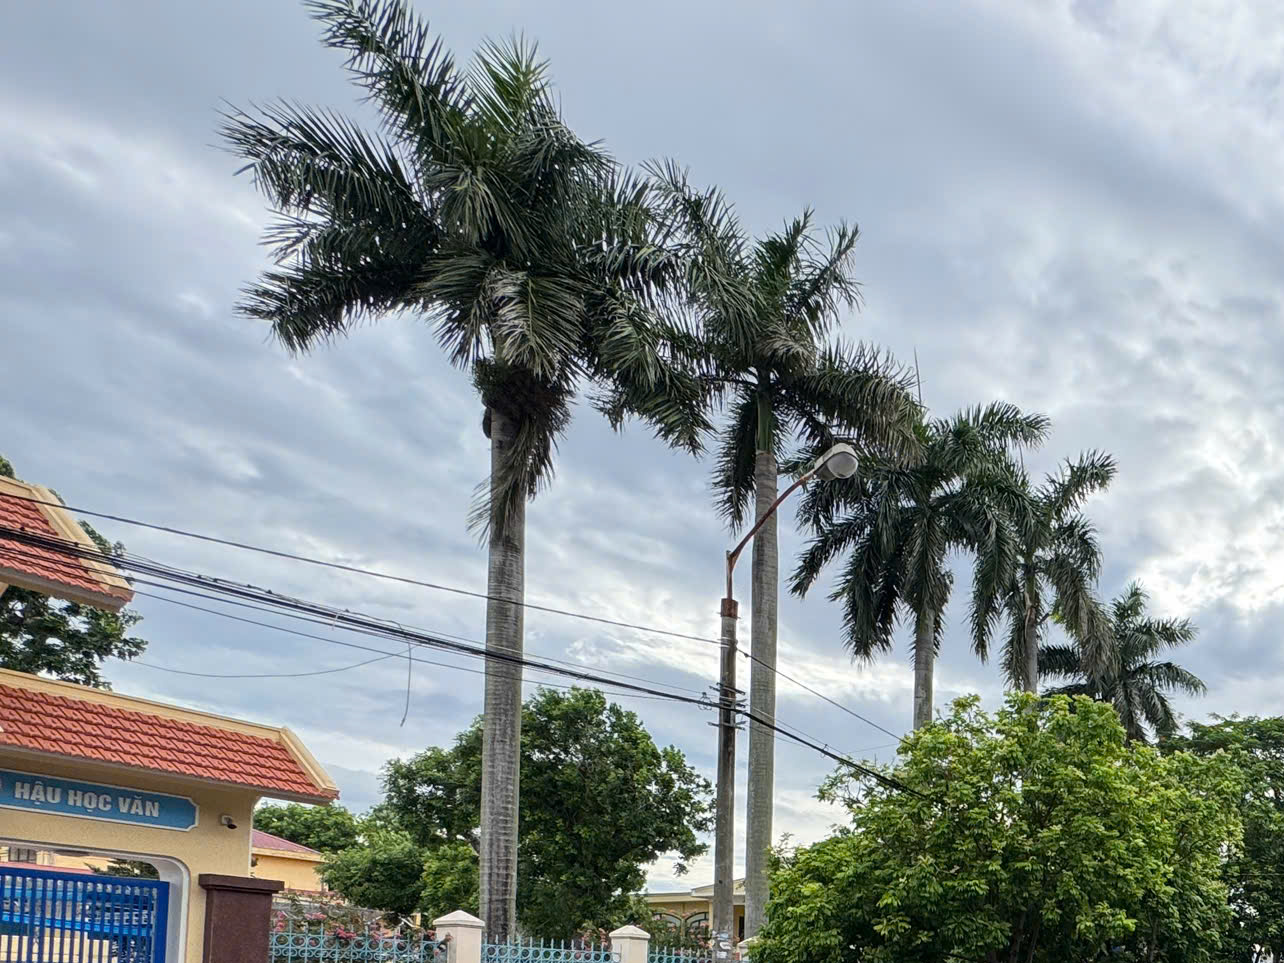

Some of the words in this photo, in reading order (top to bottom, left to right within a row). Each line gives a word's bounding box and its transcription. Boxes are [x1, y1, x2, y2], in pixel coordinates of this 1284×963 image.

[14, 781, 62, 805] HẬU
[68, 789, 112, 812] HỌC
[118, 795, 160, 818] VĂN
